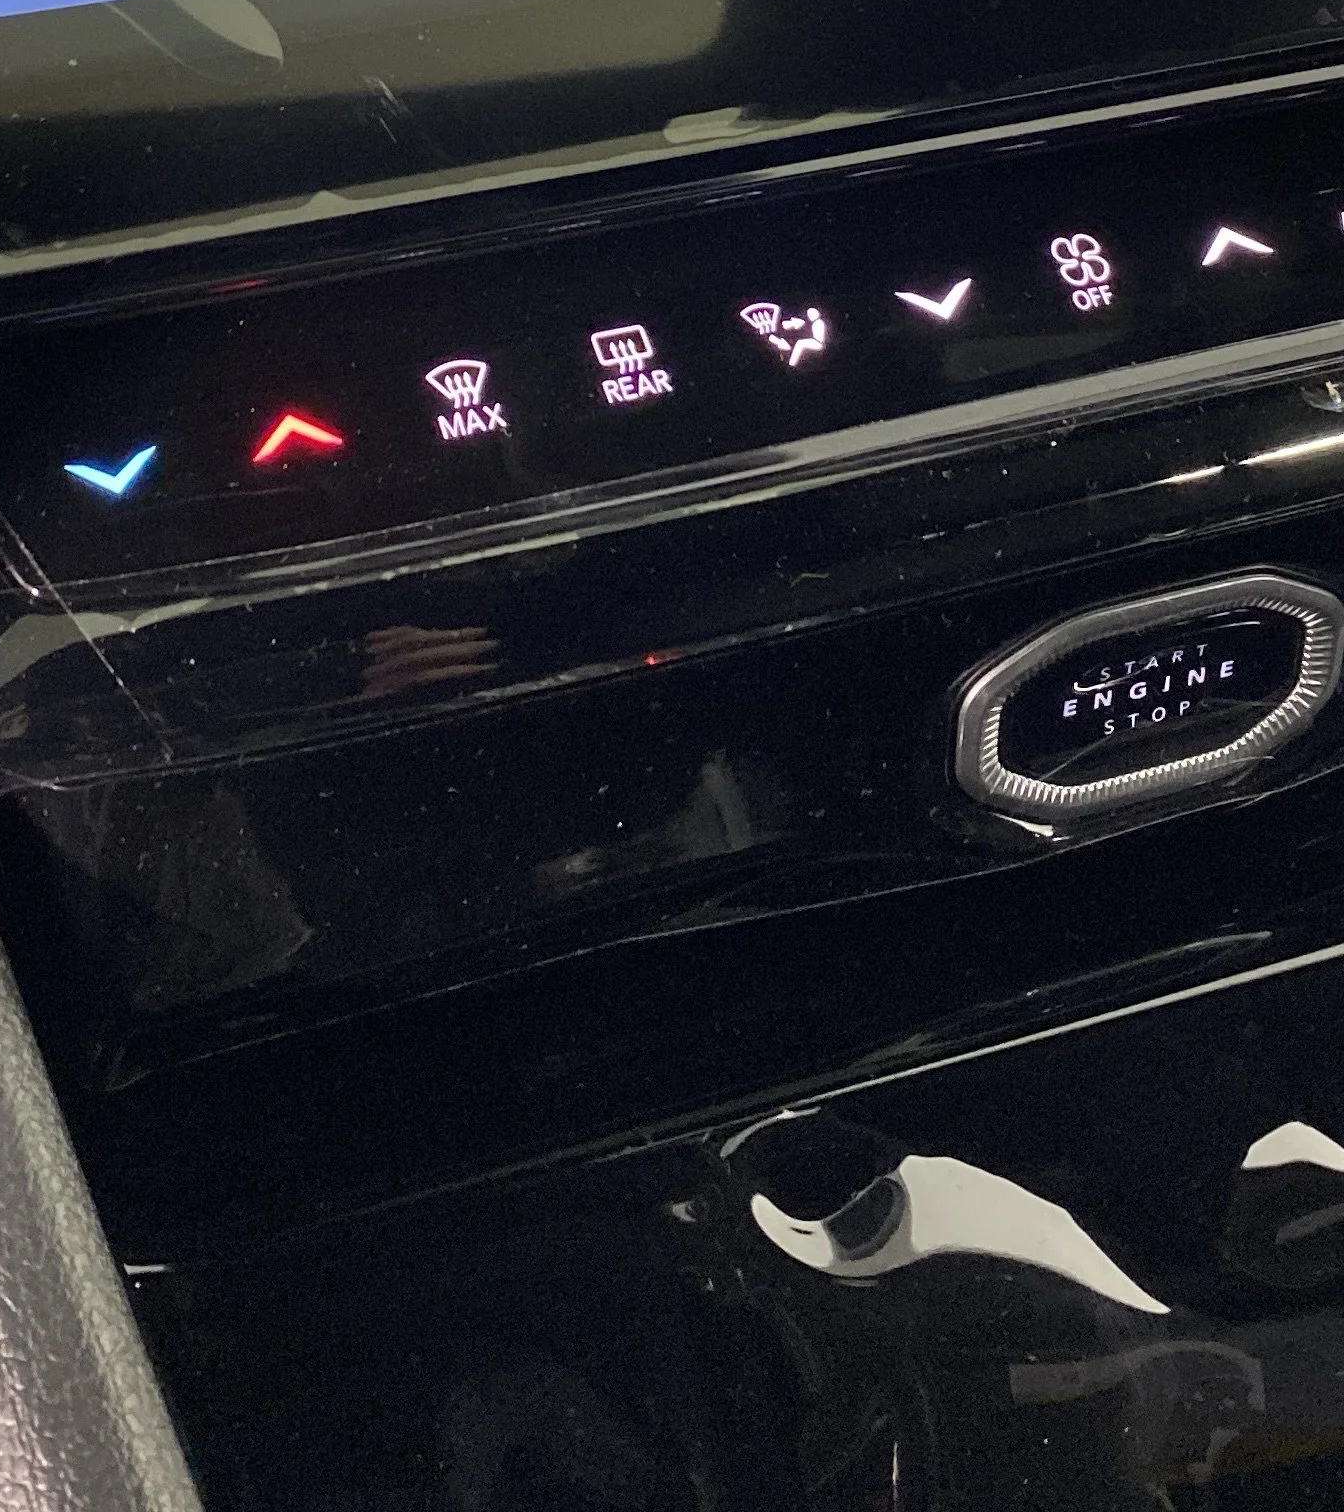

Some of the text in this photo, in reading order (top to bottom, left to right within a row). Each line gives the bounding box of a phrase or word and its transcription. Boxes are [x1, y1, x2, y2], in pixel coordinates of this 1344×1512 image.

[1071, 286, 1114, 312] OFF
[601, 368, 674, 406] REAR
[436, 402, 509, 441] MAX
[1099, 643, 1209, 682] START
[1062, 660, 1235, 718] ENGINE
[1104, 700, 1192, 735] STOP
